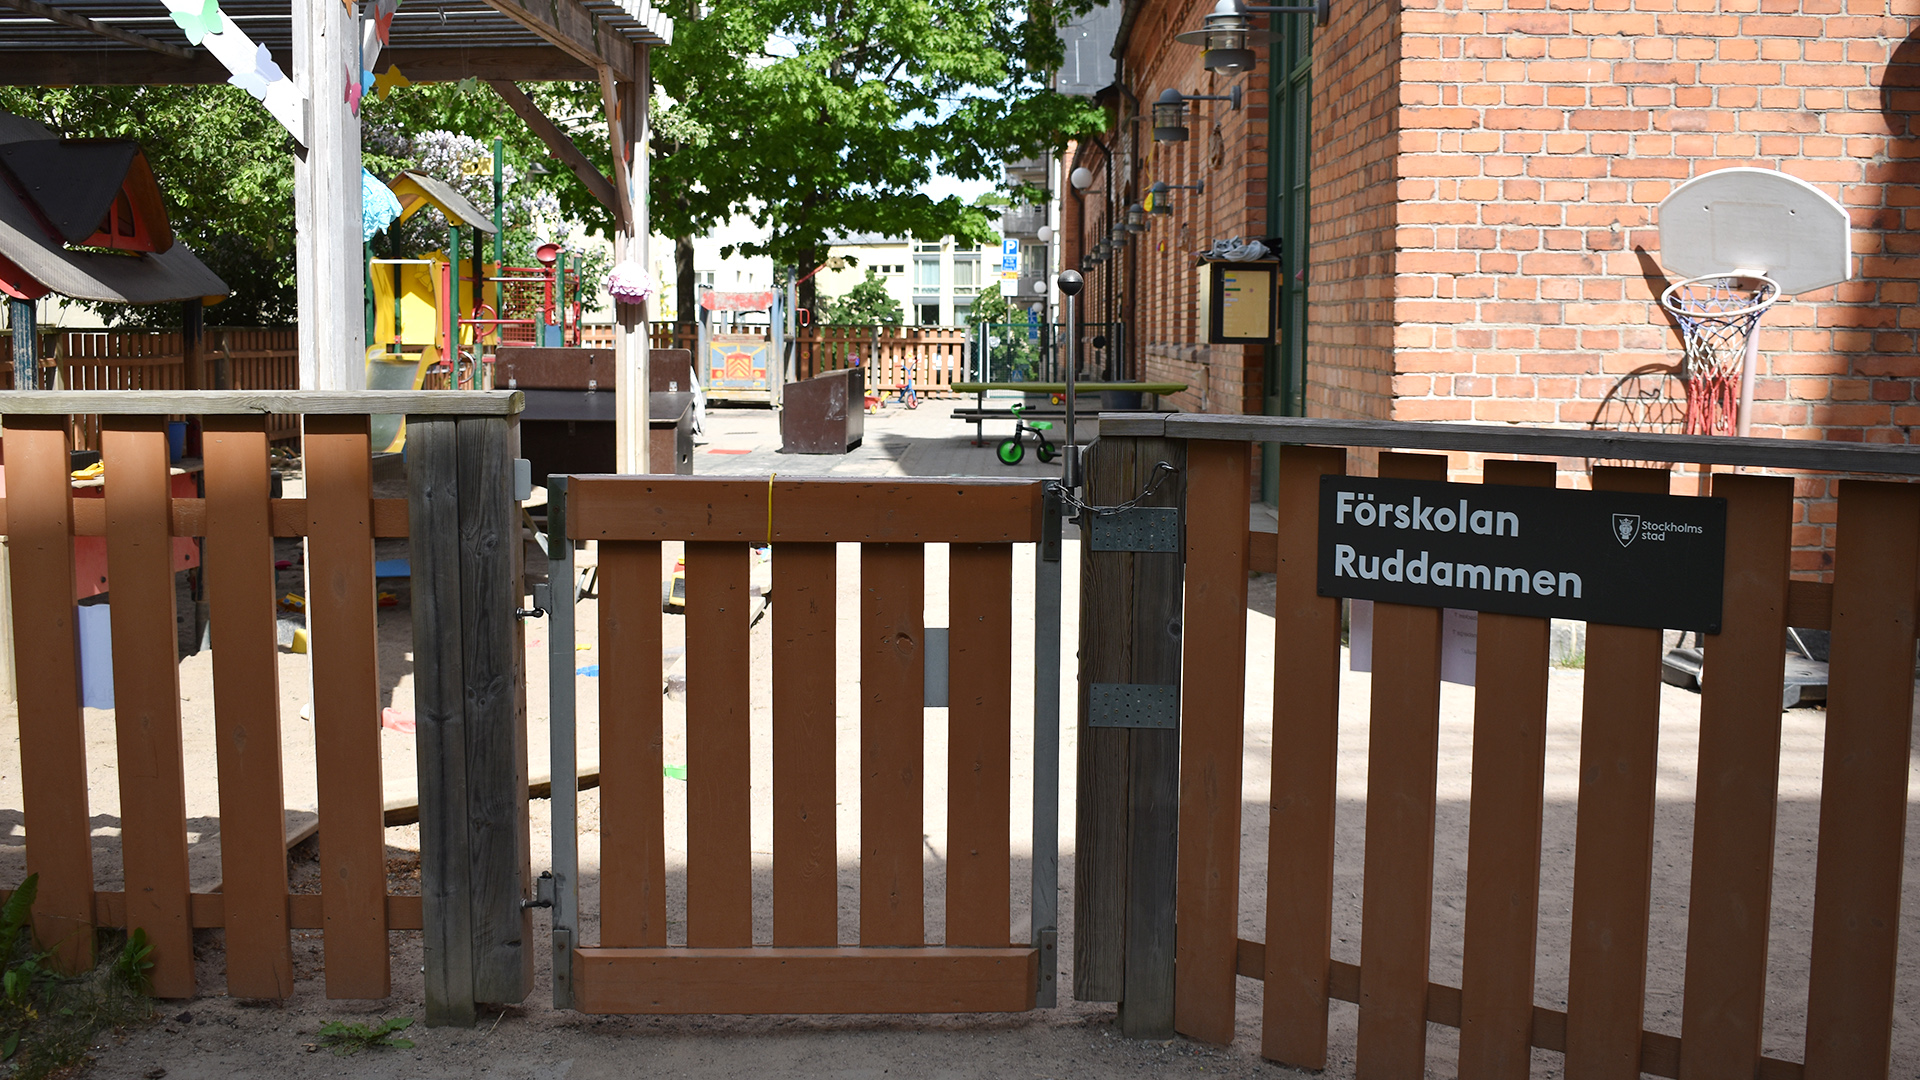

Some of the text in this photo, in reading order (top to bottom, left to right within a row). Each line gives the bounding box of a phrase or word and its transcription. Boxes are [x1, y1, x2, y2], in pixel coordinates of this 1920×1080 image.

[1006, 241, 1016, 254] P
[1335, 491, 1519, 538] Förskolan
[1641, 520, 1704, 534] Stockholms
[1641, 532, 1666, 542] stad
[1334, 543, 1582, 599] Ruddammen
